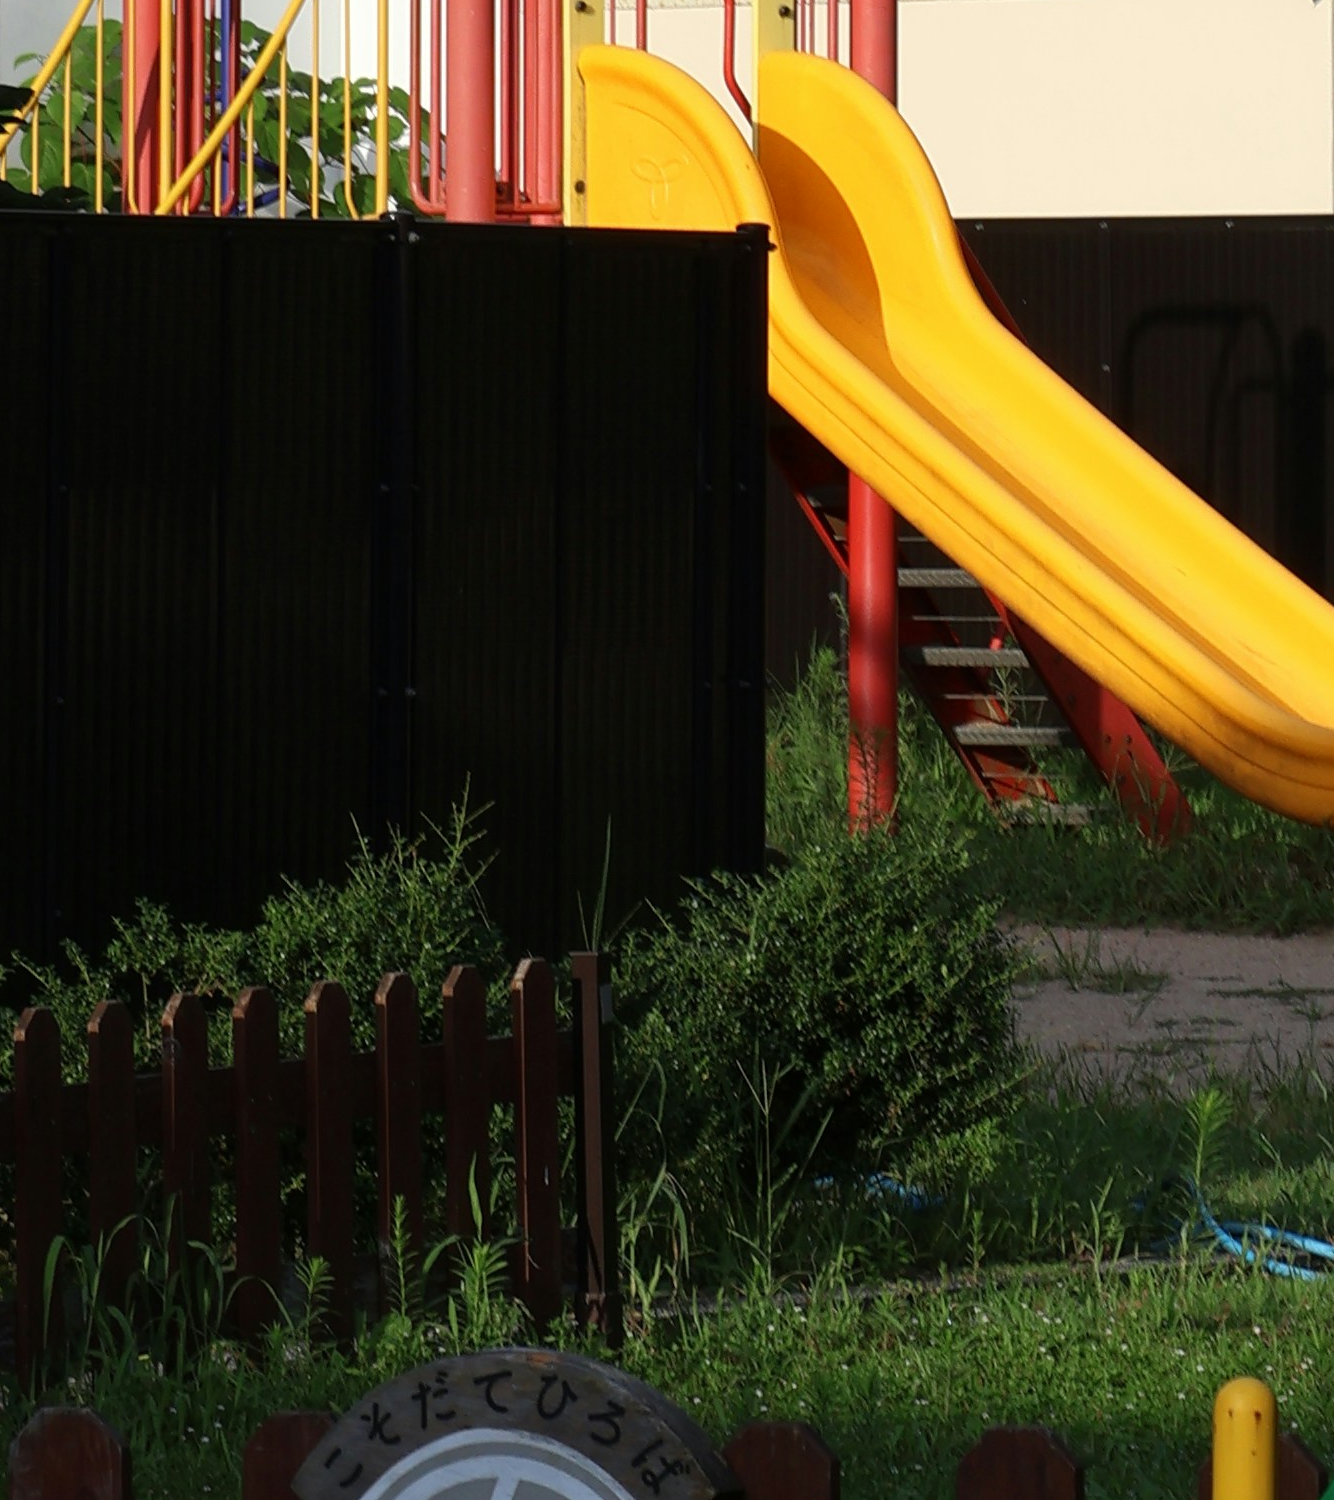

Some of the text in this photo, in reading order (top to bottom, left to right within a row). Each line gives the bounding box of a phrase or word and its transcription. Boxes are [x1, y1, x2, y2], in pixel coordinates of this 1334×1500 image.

[324, 1369, 691, 1496] こそだてひろば
